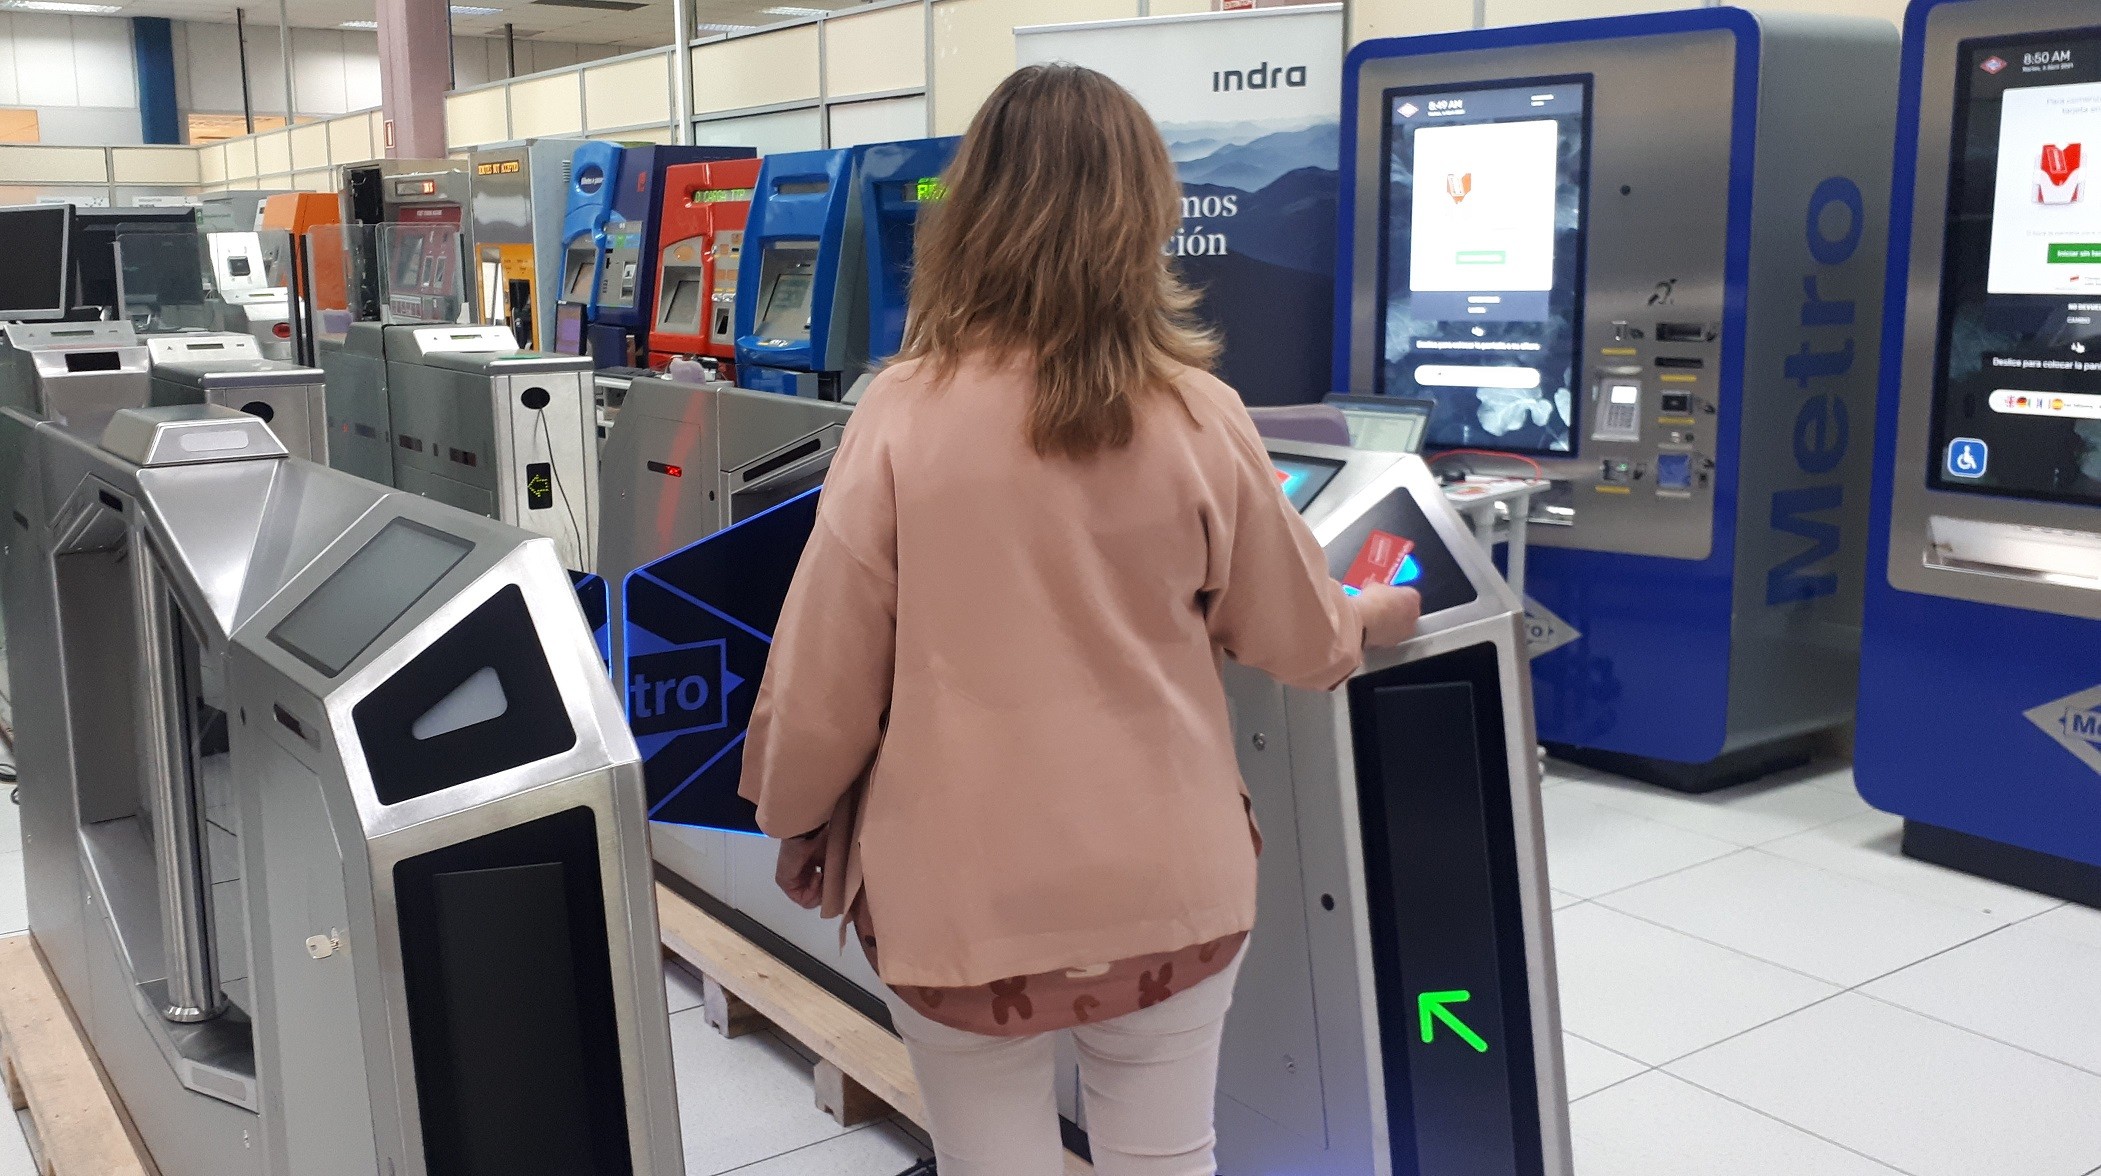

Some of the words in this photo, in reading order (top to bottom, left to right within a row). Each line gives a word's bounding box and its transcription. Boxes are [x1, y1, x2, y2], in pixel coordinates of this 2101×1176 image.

[2024, 53, 2050, 65] 8:50
[2052, 50, 2071, 62] AM
[1213, 62, 1307, 92] indra
[1448, 99, 1464, 109] AM
[1992, 357, 2022, 367] Deslice
[2022, 360, 2042, 369] para
[2043, 360, 2074, 370] colocar
[2074, 361, 2083, 370] la
[1766, 176, 1865, 607] Metro
